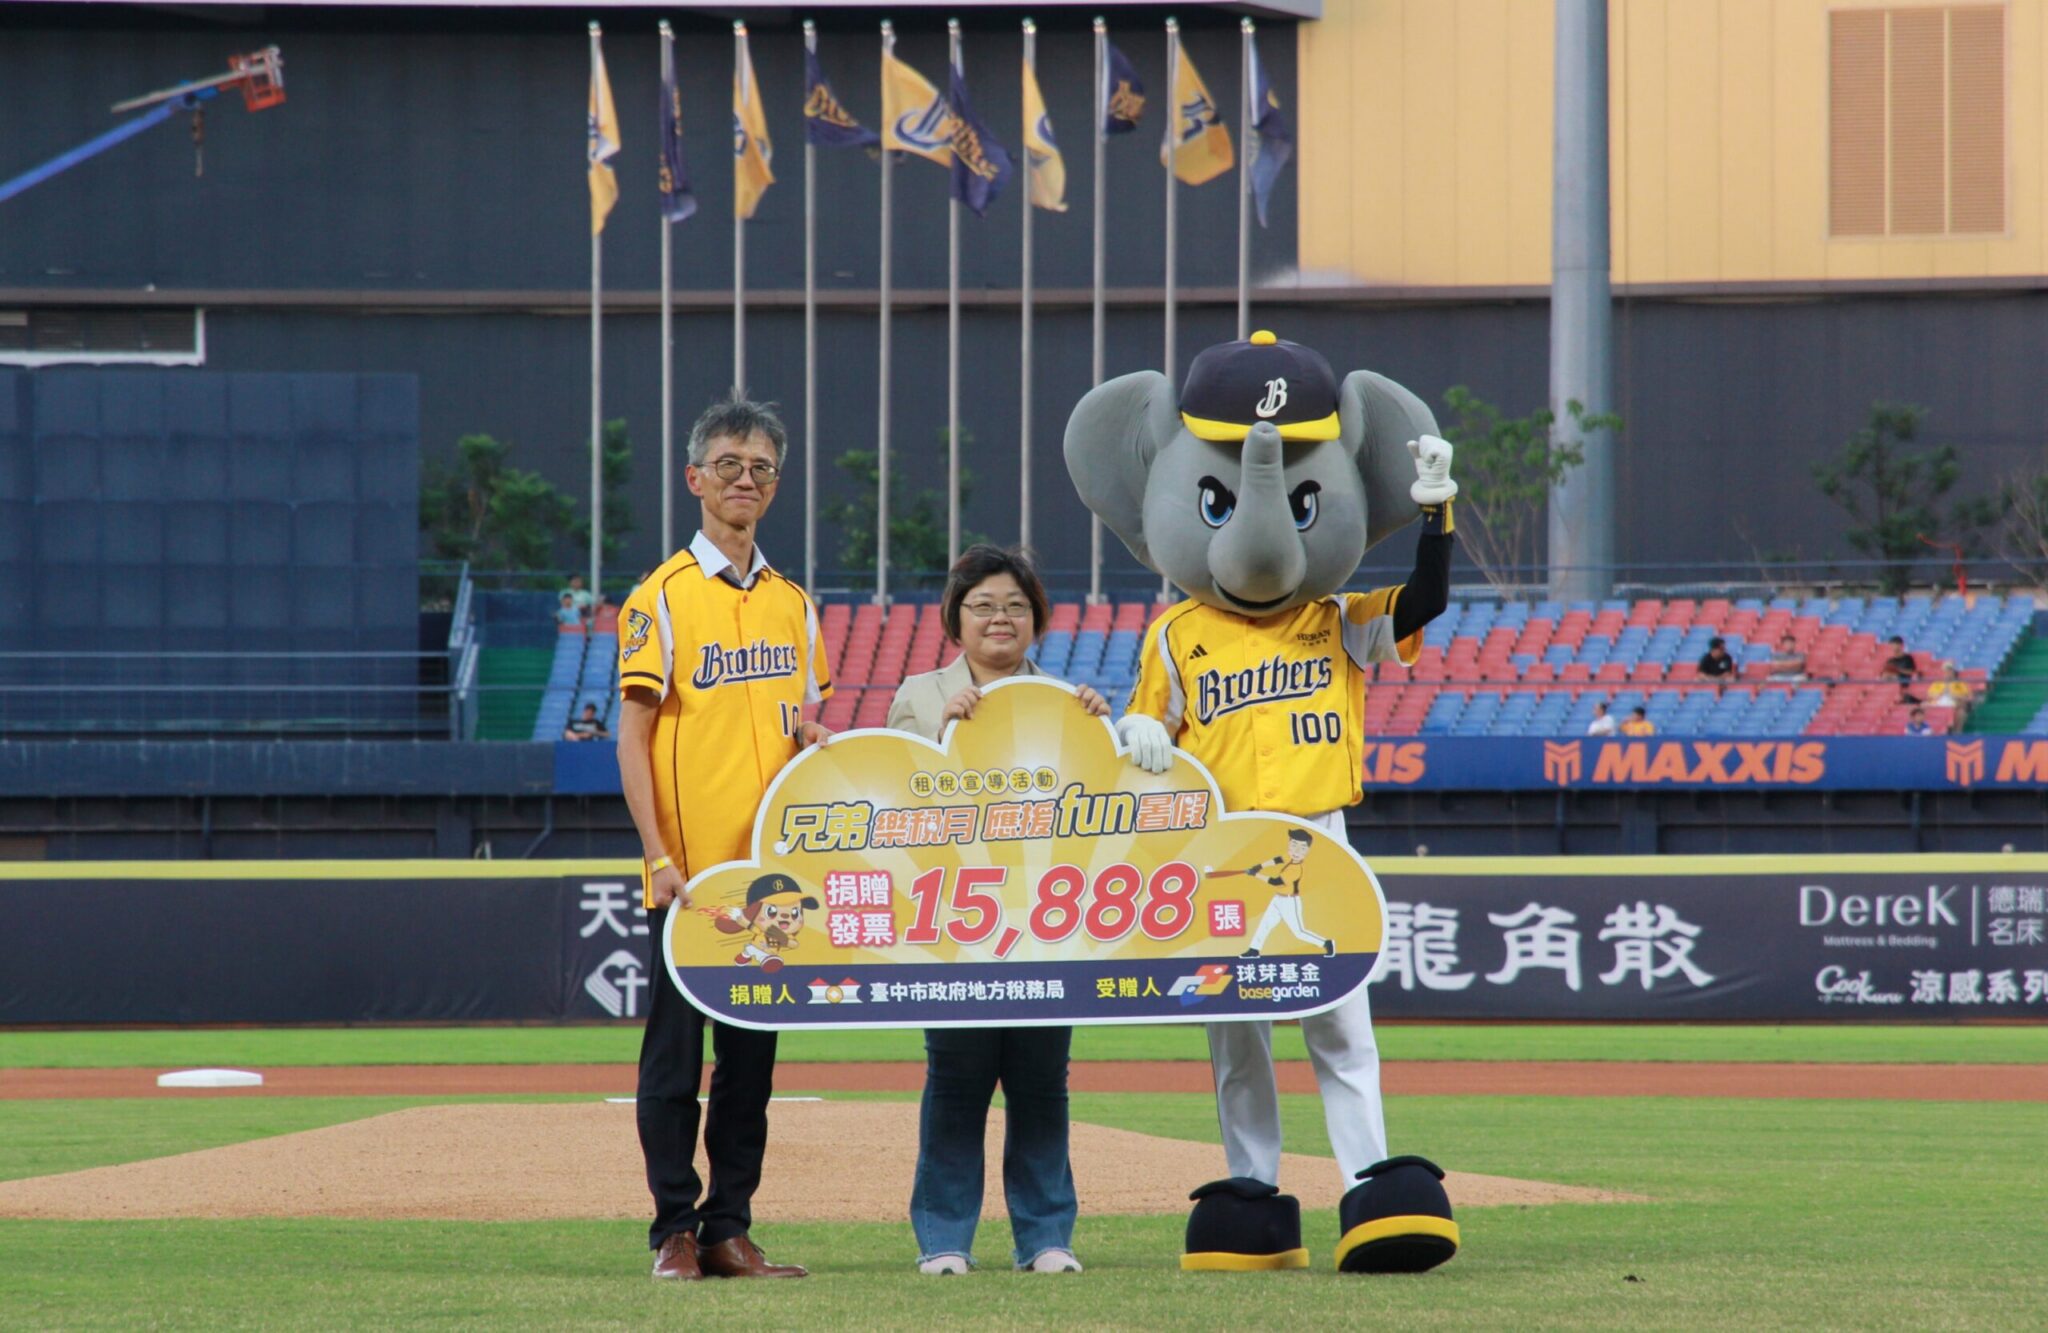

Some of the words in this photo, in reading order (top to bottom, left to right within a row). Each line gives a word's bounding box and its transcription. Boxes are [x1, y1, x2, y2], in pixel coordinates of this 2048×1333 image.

[1255, 377, 1288, 418] B
[692, 639, 798, 690] Brothers
[1196, 655, 1332, 726] Brothers
[1290, 712, 1342, 745] 100
[1592, 742, 1826, 783] MAXXIS
[827, 874, 890, 906] 捐贈
[1988, 886, 2048, 913] 德瑞
[904, 861, 1199, 959] 15,888
[1214, 904, 1241, 931] 張
[829, 913, 893, 945] 發票
[1988, 917, 2044, 945] 名床
[1369, 901, 1716, 991] 龍角散
[1096, 977, 1161, 999] 受贈人
[1236, 963, 1320, 984] 球芽基金
[729, 984, 796, 1006] 捐贈人
[1238, 983, 1319, 1002] basegarden
